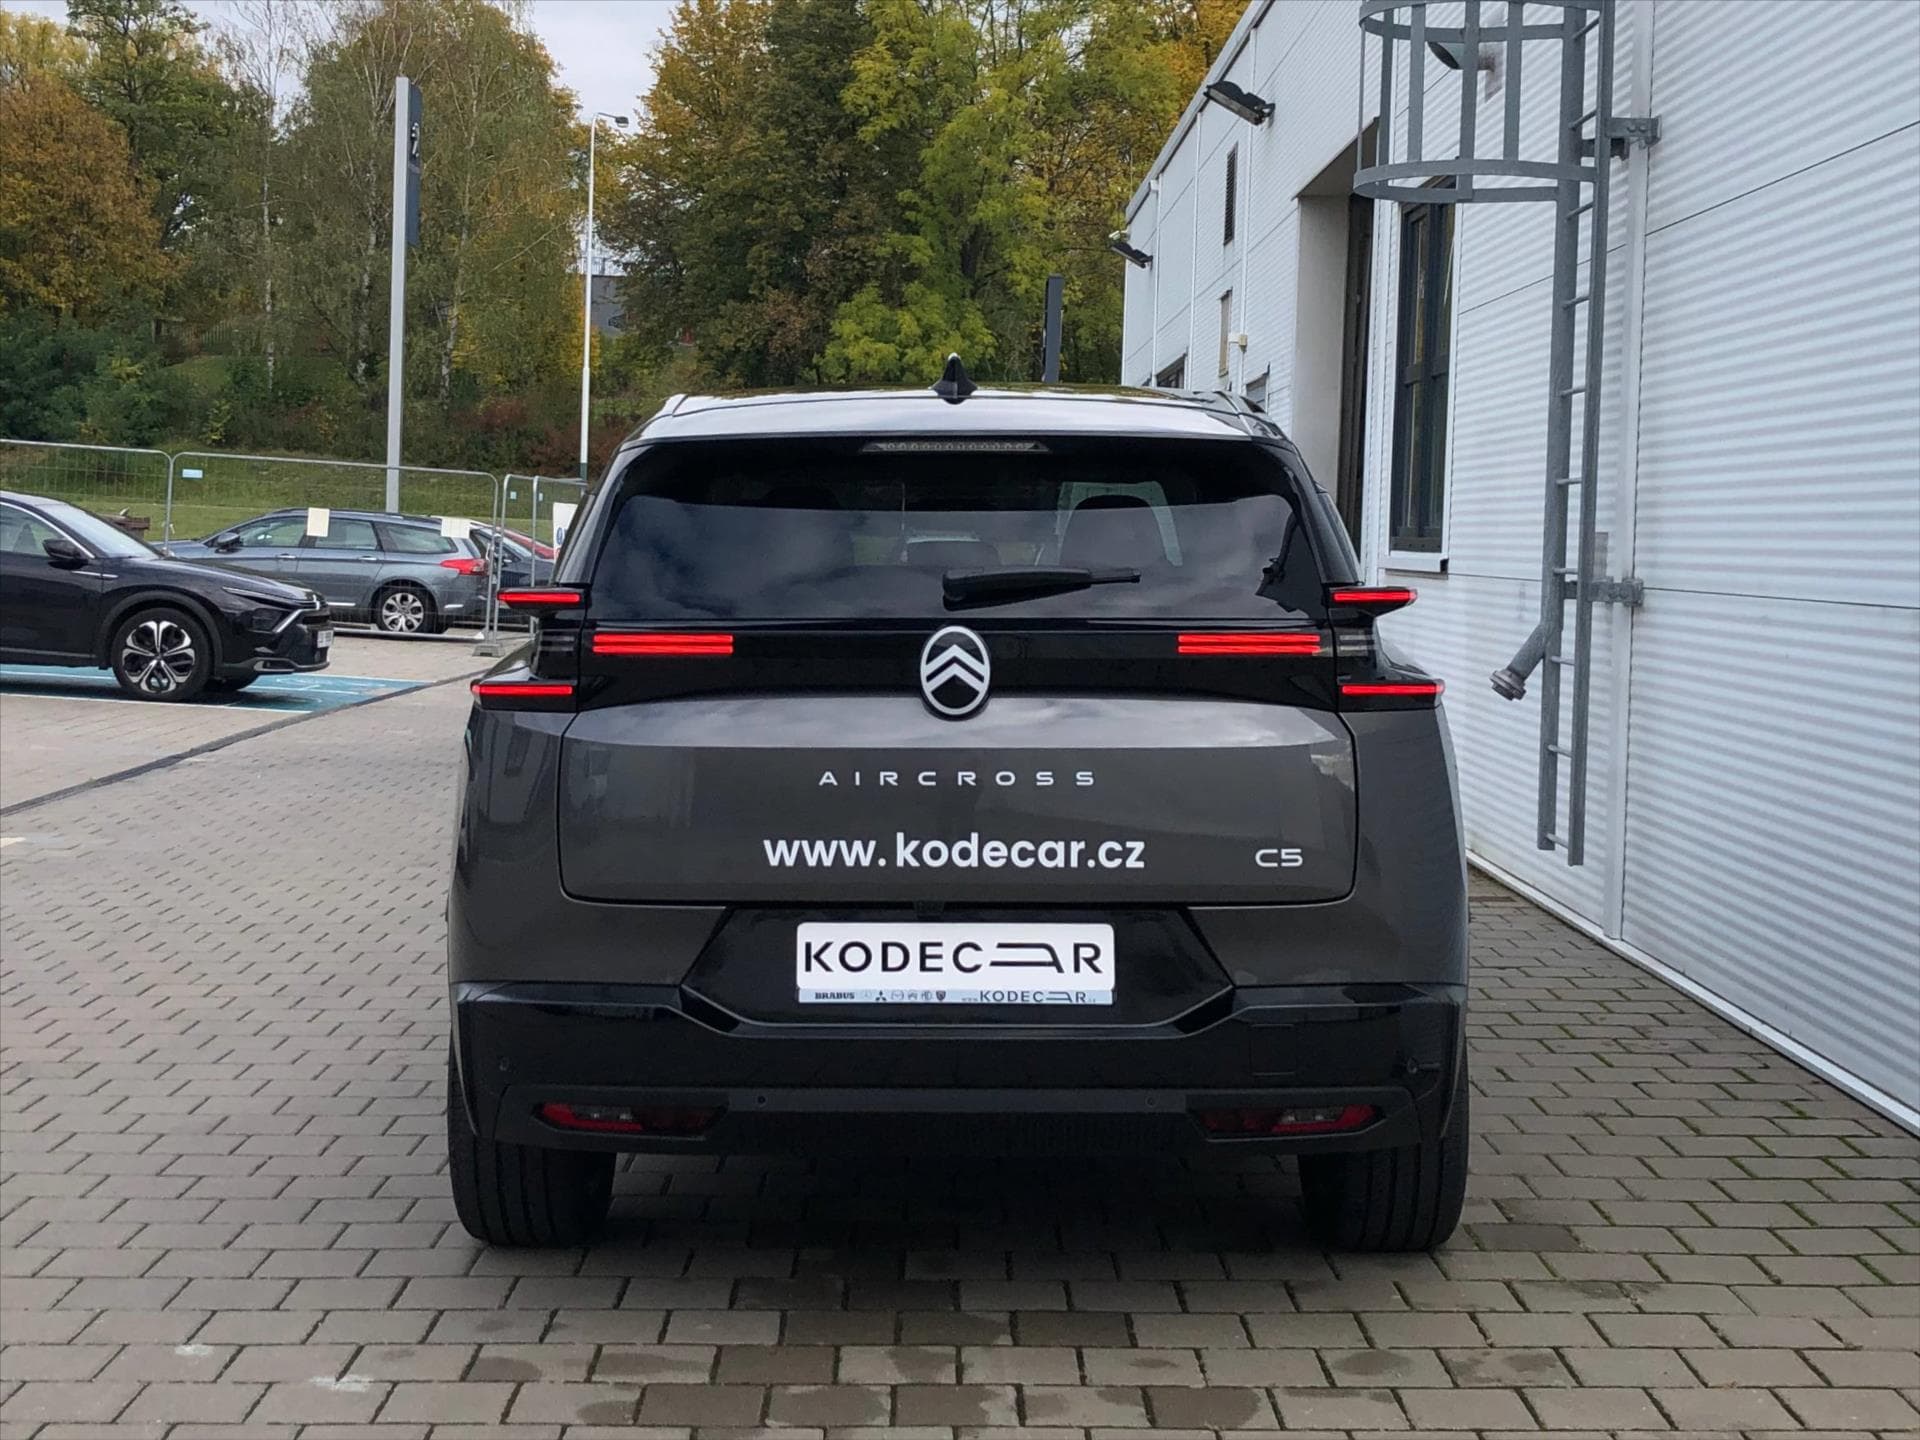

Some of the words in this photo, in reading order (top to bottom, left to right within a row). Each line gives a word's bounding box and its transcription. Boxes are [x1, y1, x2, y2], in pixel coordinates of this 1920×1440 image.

[818, 770, 1095, 787] AIRCROSS
[1255, 848, 1304, 867] C5
[804, 941, 1103, 974] KODECAR
[815, 992, 855, 1000] BRABUS
